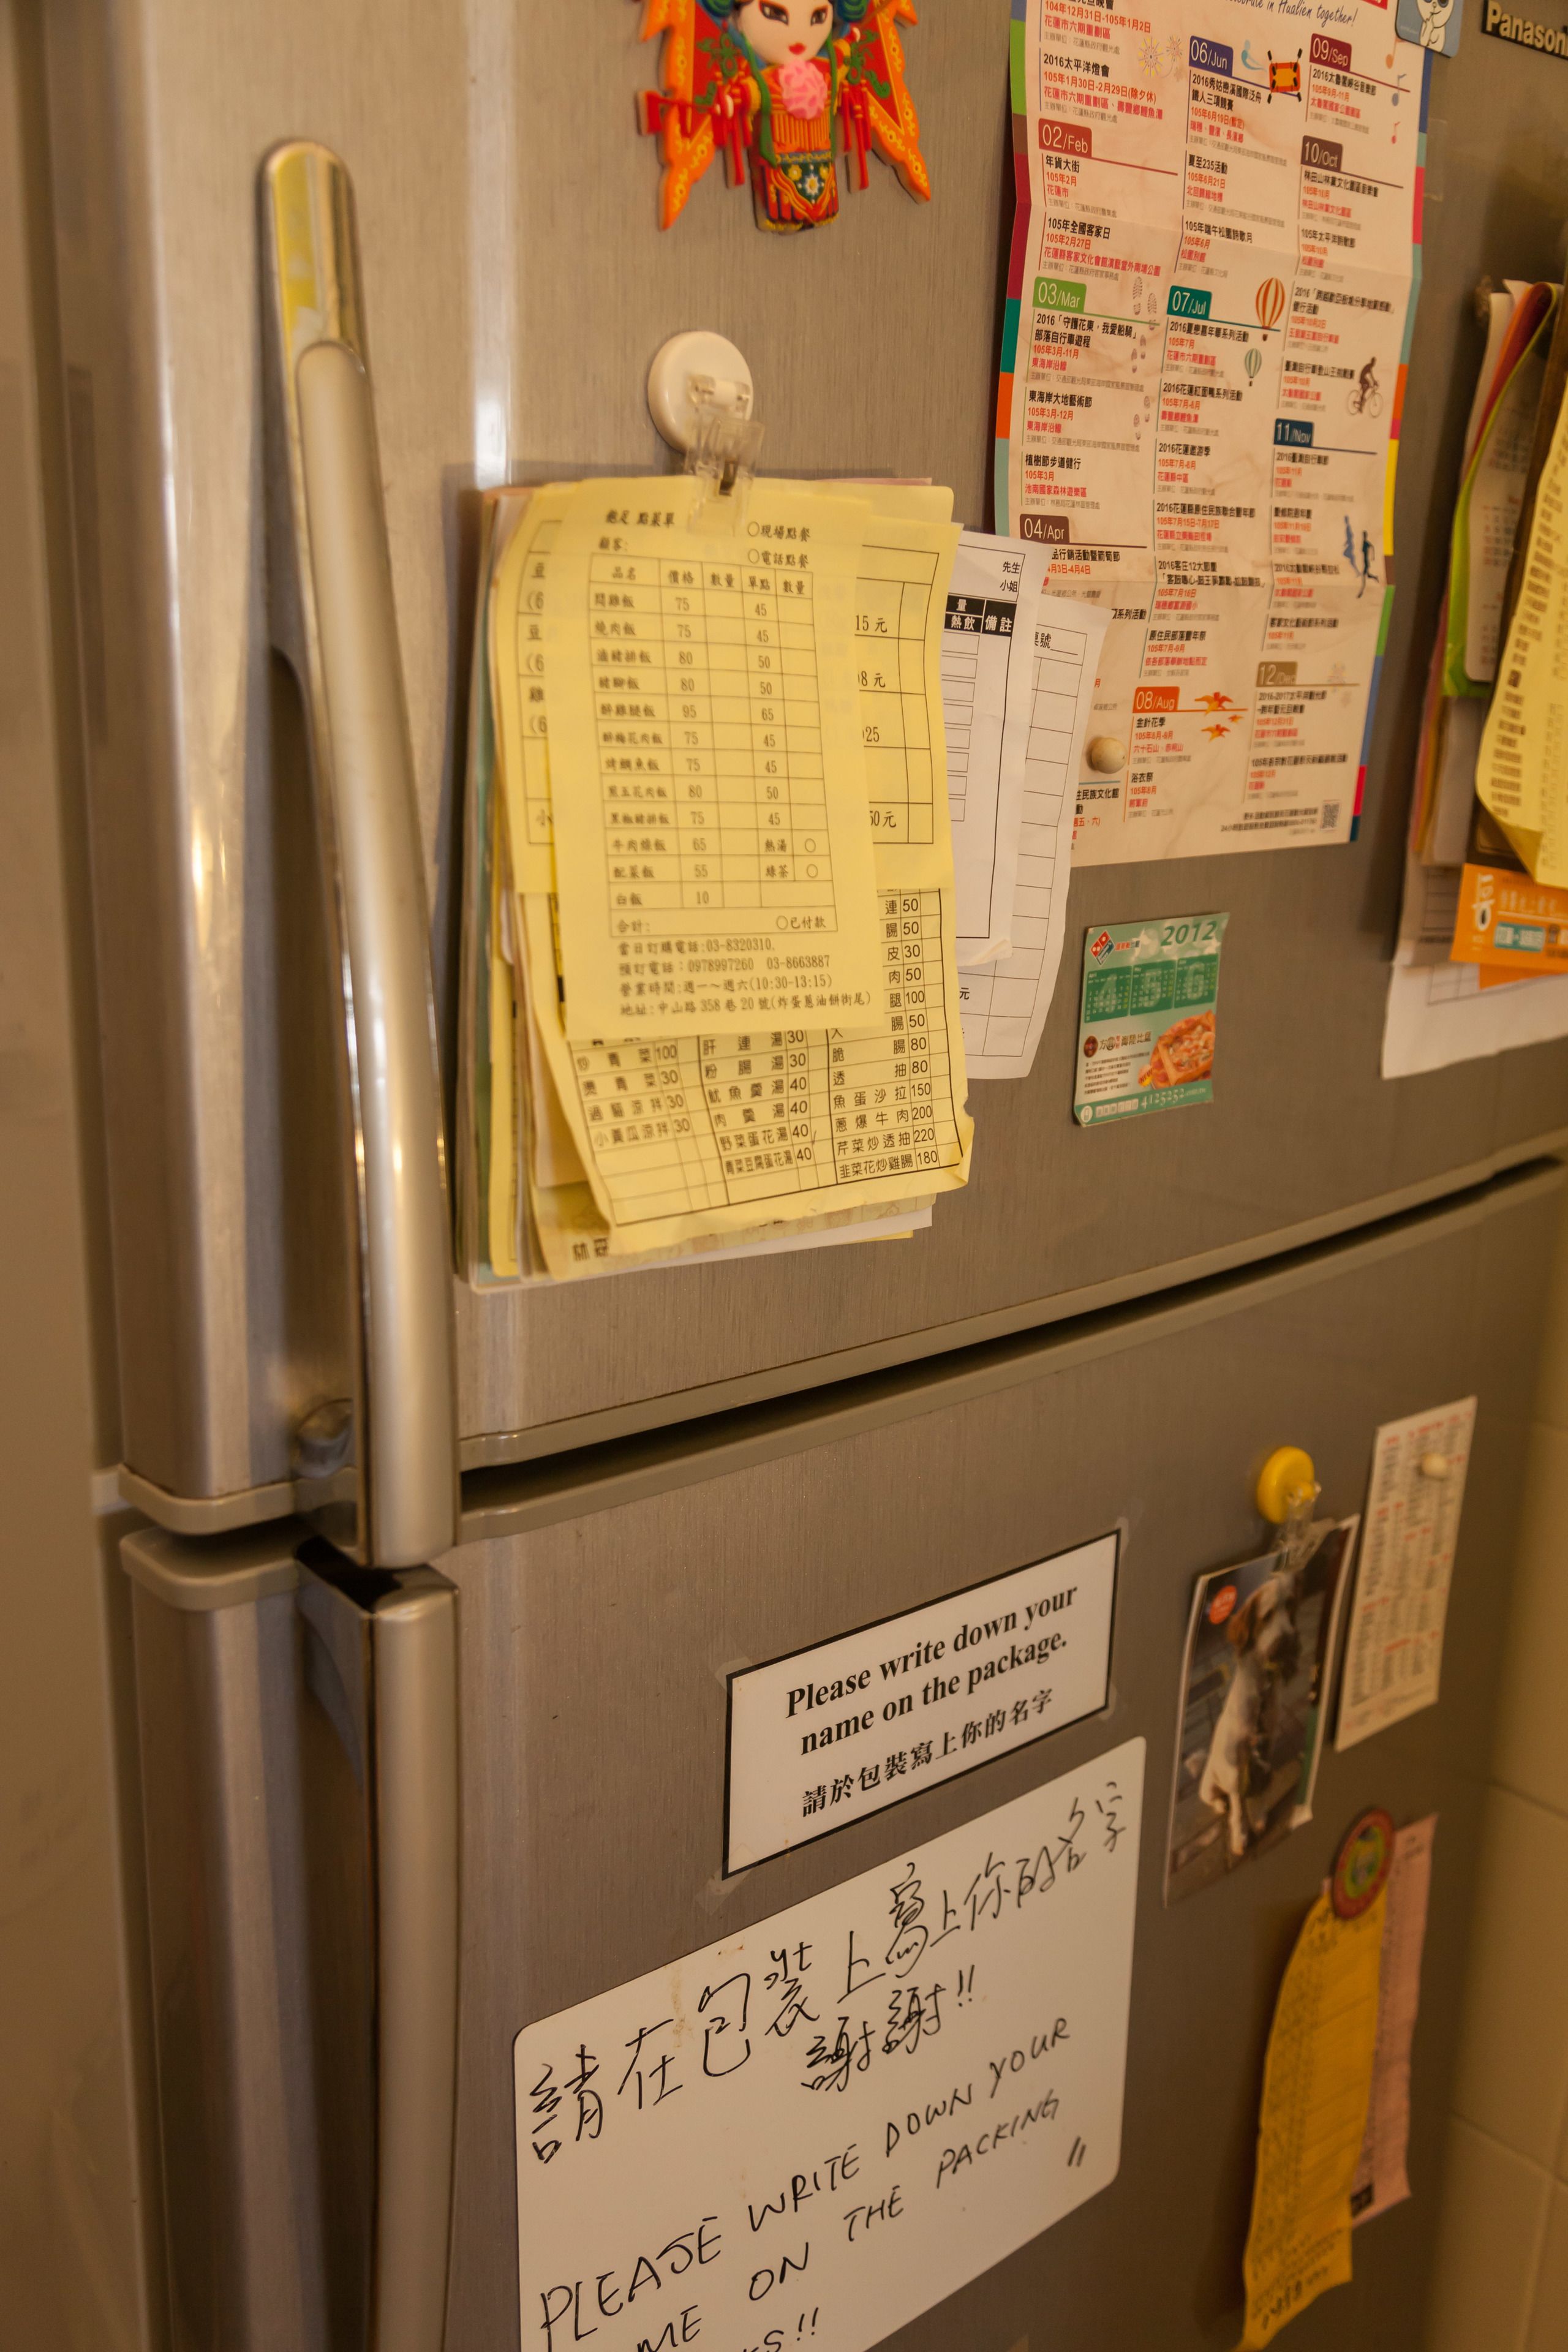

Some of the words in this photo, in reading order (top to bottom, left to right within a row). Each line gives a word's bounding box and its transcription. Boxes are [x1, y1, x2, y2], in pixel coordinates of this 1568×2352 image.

[1316, 5, 1359, 28] together!
[1190, 39, 1228, 70] 06/Jun
[1312, 37, 1349, 67] 09/Sep
[1044, 53, 1110, 77] 2016太平洋燈會
[1042, 124, 1088, 153] 02/Feb
[1305, 141, 1338, 168] 10/Oct
[1046, 155, 1080, 173] 年貨大街
[1188, 154, 1228, 175] 夏至235活動
[1046, 172, 1077, 187] 105年2月
[1047, 186, 1069, 198] 花蓮市
[1047, 217, 1110, 239] 105年全國客家日
[1046, 233, 1091, 250] 105年2月27日
[1185, 236, 1210, 249] 105年6月
[1038, 282, 1080, 309] 03/Mar
[1172, 290, 1206, 315] 07/Jul
[1169, 337, 1194, 349] 105年7月
[1033, 344, 1079, 359] 105年3月-11月
[1029, 390, 1093, 409] 東海岸大地藝術節
[1028, 407, 1074, 421] 105年3月-12月
[1276, 422, 1311, 443] 11/Nov
[1025, 454, 1082, 470] 植樹節步道健行
[1025, 470, 1055, 482] 105年3月
[1024, 518, 1065, 541] 04/Apr
[1003, 562, 1020, 575] 先生
[1000, 581, 1018, 593] 小姐
[676, 597, 690, 611] 75
[755, 603, 767, 616] 45
[874, 616, 888, 633] 元
[951, 615, 975, 631] 熱飲
[985, 616, 1012, 633] 備註
[677, 625, 692, 638] 75
[757, 630, 769, 643] 45
[679, 651, 693, 665] 80
[758, 655, 771, 669] 50
[680, 678, 695, 692] 80
[760, 682, 772, 695] 50
[873, 674, 886, 688] 元
[1135, 691, 1175, 710] 08/Aug
[682, 705, 696, 719] 95
[762, 708, 774, 722] 65
[684, 731, 699, 745] 75
[764, 734, 775, 747] 45
[687, 758, 701, 772] 75
[766, 761, 777, 774] 45
[688, 785, 703, 798] 80
[767, 786, 779, 799] 50
[691, 812, 705, 825] 75
[769, 813, 781, 826] 45
[695, 865, 709, 878] 55
[696, 891, 709, 905] 10
[902, 898, 919, 912] 50
[886, 922, 898, 938] 腸
[903, 921, 919, 935] 50
[1161, 921, 1218, 946] 2012
[888, 946, 900, 961] 皮
[904, 944, 920, 958] 30
[767, 955, 831, 970] 03-8663887
[889, 970, 900, 984] 肉
[905, 967, 921, 981] 50
[701, 998, 721, 1012] 358
[741, 997, 754, 1011] 20
[905, 990, 925, 1004] 100
[909, 1014, 925, 1028] 50
[788, 1030, 804, 1043] 30
[911, 1037, 927, 1050] 80
[657, 1044, 677, 1060] 100
[790, 1053, 806, 1067] 30
[912, 1060, 928, 1074] 80
[661, 1069, 678, 1085] 30
[790, 1077, 807, 1090] 40
[667, 1094, 684, 1109] 30
[834, 1085, 907, 1109] 魚蛋沙拉
[910, 1082, 931, 1096] 150
[790, 1101, 807, 1114] 40
[913, 1106, 932, 1120] 200
[674, 1118, 690, 1133] 30
[793, 1123, 809, 1137] 40
[837, 1131, 911, 1156] 芹菜炒透抽
[914, 1128, 934, 1143] 220
[797, 1147, 812, 1161] 40
[917, 1150, 938, 1165] 180
[785, 1668, 871, 1719] Please
[879, 1639, 946, 1682] write
[953, 1611, 1017, 1653] down
[1023, 1586, 1078, 1631] your
[801, 1709, 875, 1755] name
[883, 1692, 914, 1722] on
[922, 1671, 960, 1706] the
[968, 1631, 1067, 1695] package.
[802, 1689, 1053, 1817] 請於包裝寫上你的名字
[540, 2216, 722, 2352] PLEASE
[748, 2144, 859, 2231] WRITE
[886, 2083, 972, 2157] DOWN
[989, 2018, 1071, 2098] YOUR
[638, 2305, 701, 2352] ME
[748, 2242, 809, 2301] ON
[843, 2184, 905, 2243] THE
[936, 2088, 1060, 2189] PACKING
